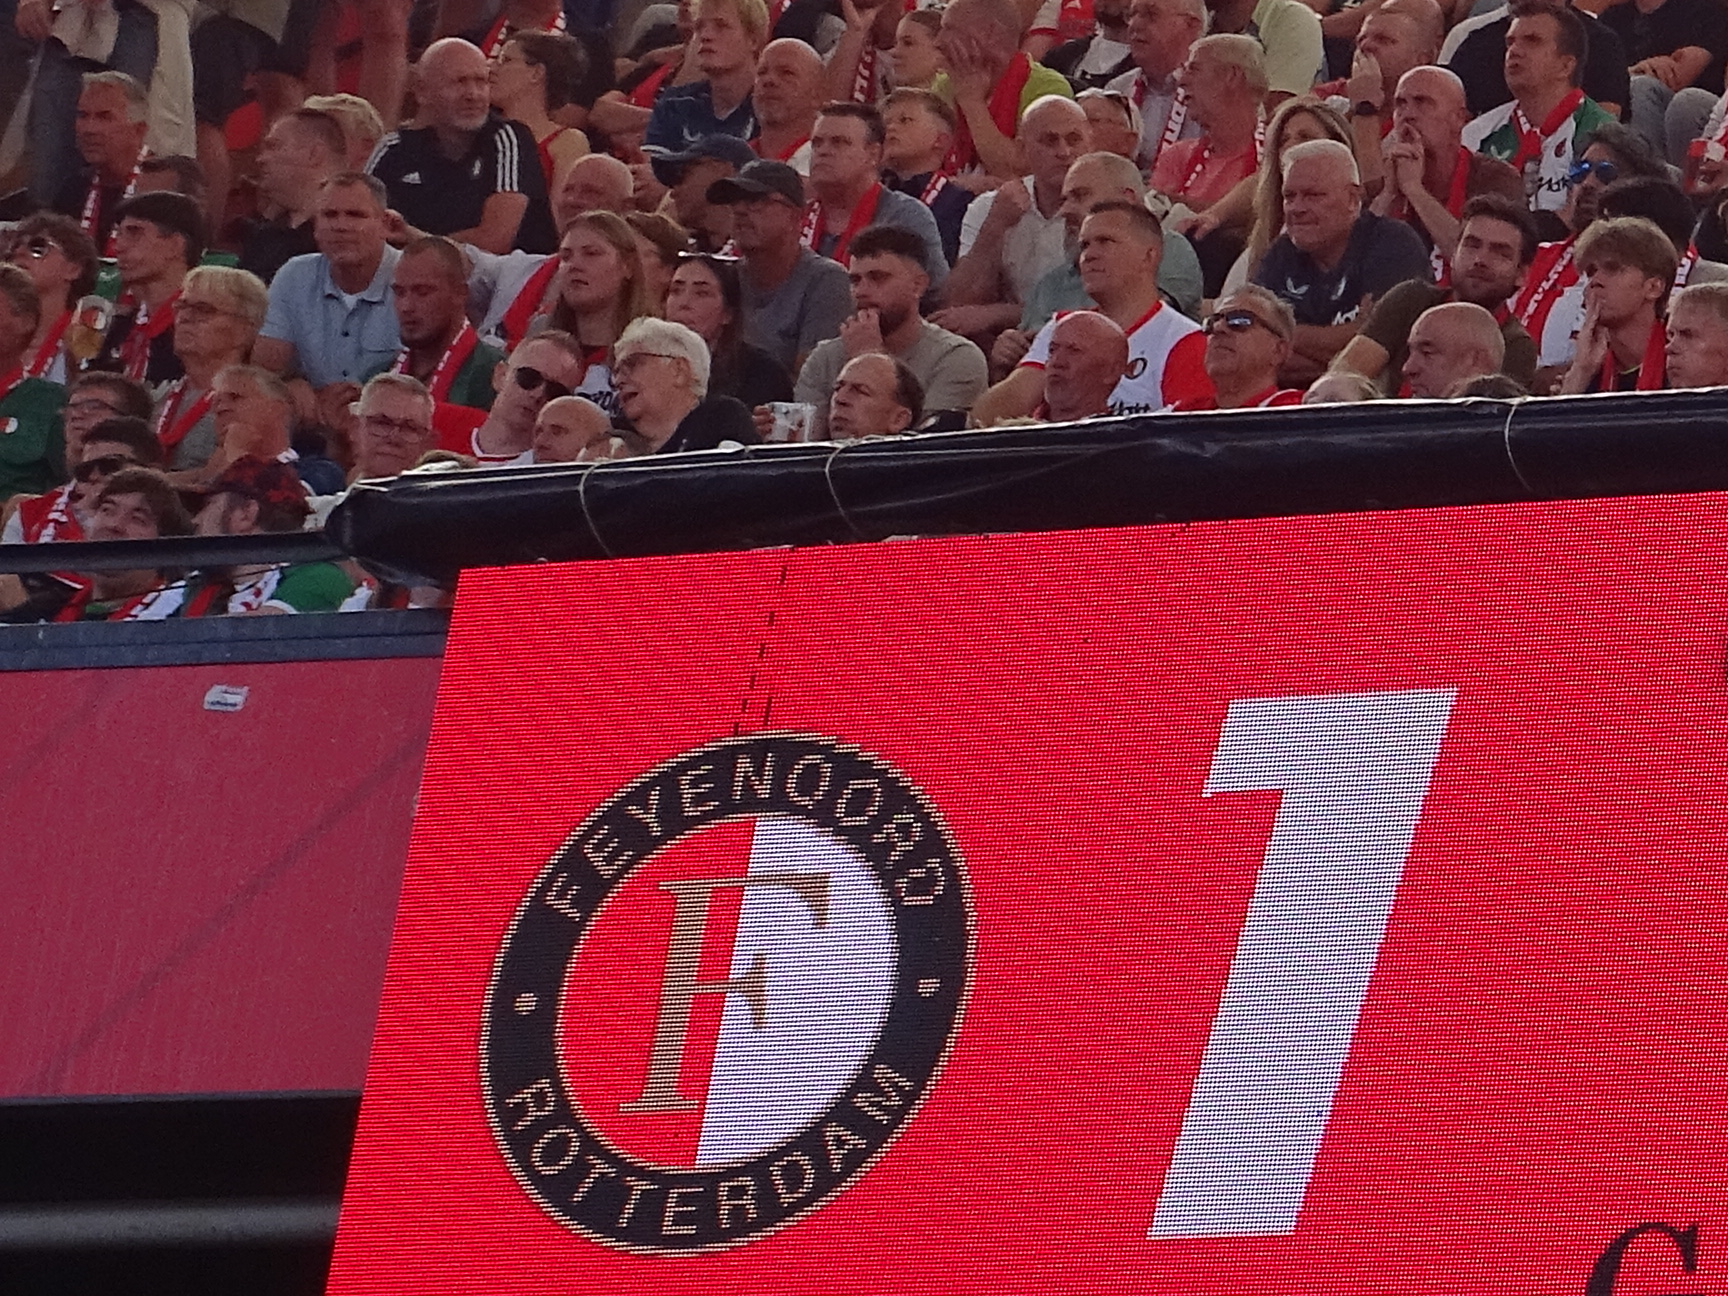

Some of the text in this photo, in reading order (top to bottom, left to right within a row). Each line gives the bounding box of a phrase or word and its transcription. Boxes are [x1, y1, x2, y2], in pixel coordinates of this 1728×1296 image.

[544, 752, 946, 922] FEYENOORD
[1147, 686, 1458, 1241] 1
[506, 1063, 914, 1236] ROTTERDAM
